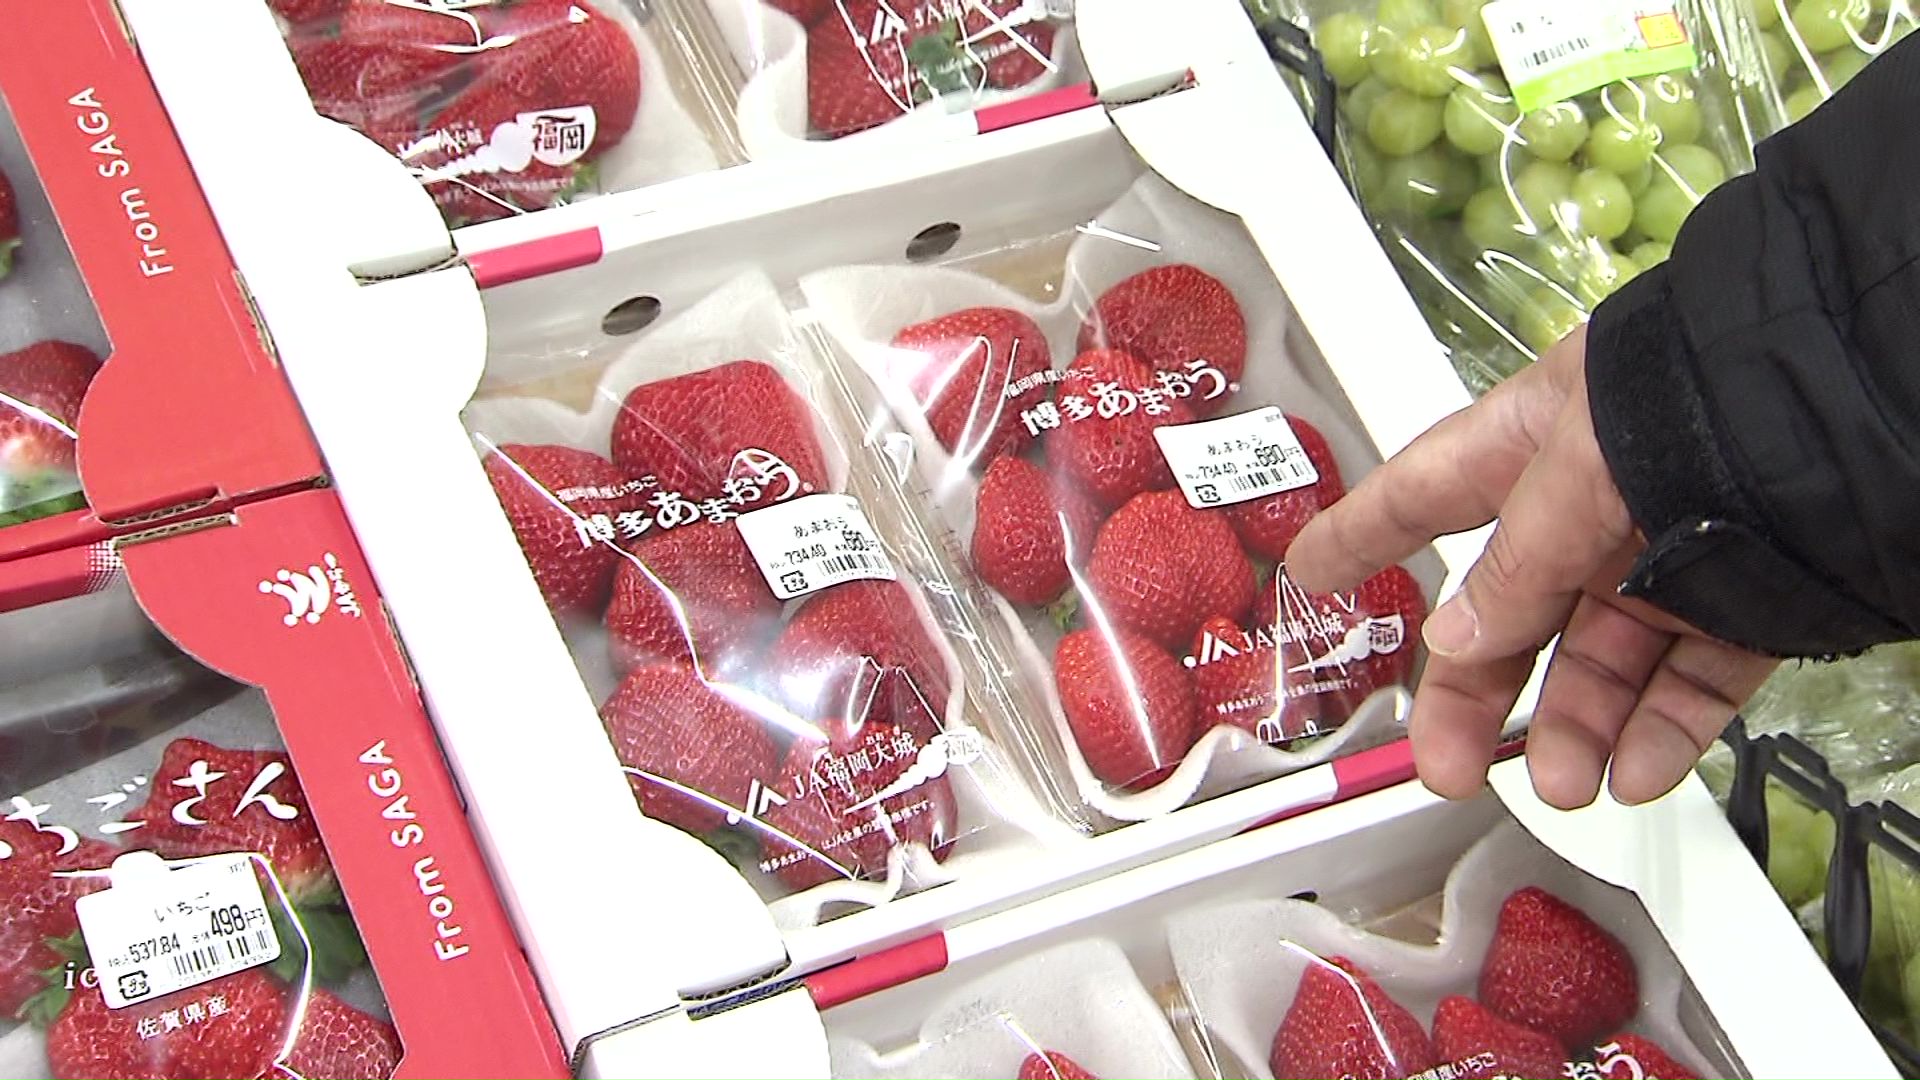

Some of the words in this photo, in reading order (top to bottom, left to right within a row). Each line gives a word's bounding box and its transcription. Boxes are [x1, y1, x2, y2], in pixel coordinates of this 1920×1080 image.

[67, 87, 130, 178] SAGA
[532, 114, 586, 153] 福岡
[120, 188, 174, 277] From
[0, 759, 299, 860] ちごさん
[359, 740, 424, 847] SAGA
[128, 933, 181, 964] 537.84
[154, 892, 210, 922] いちご
[412, 856, 470, 961] From
[136, 993, 231, 1040] 佐賀県産
